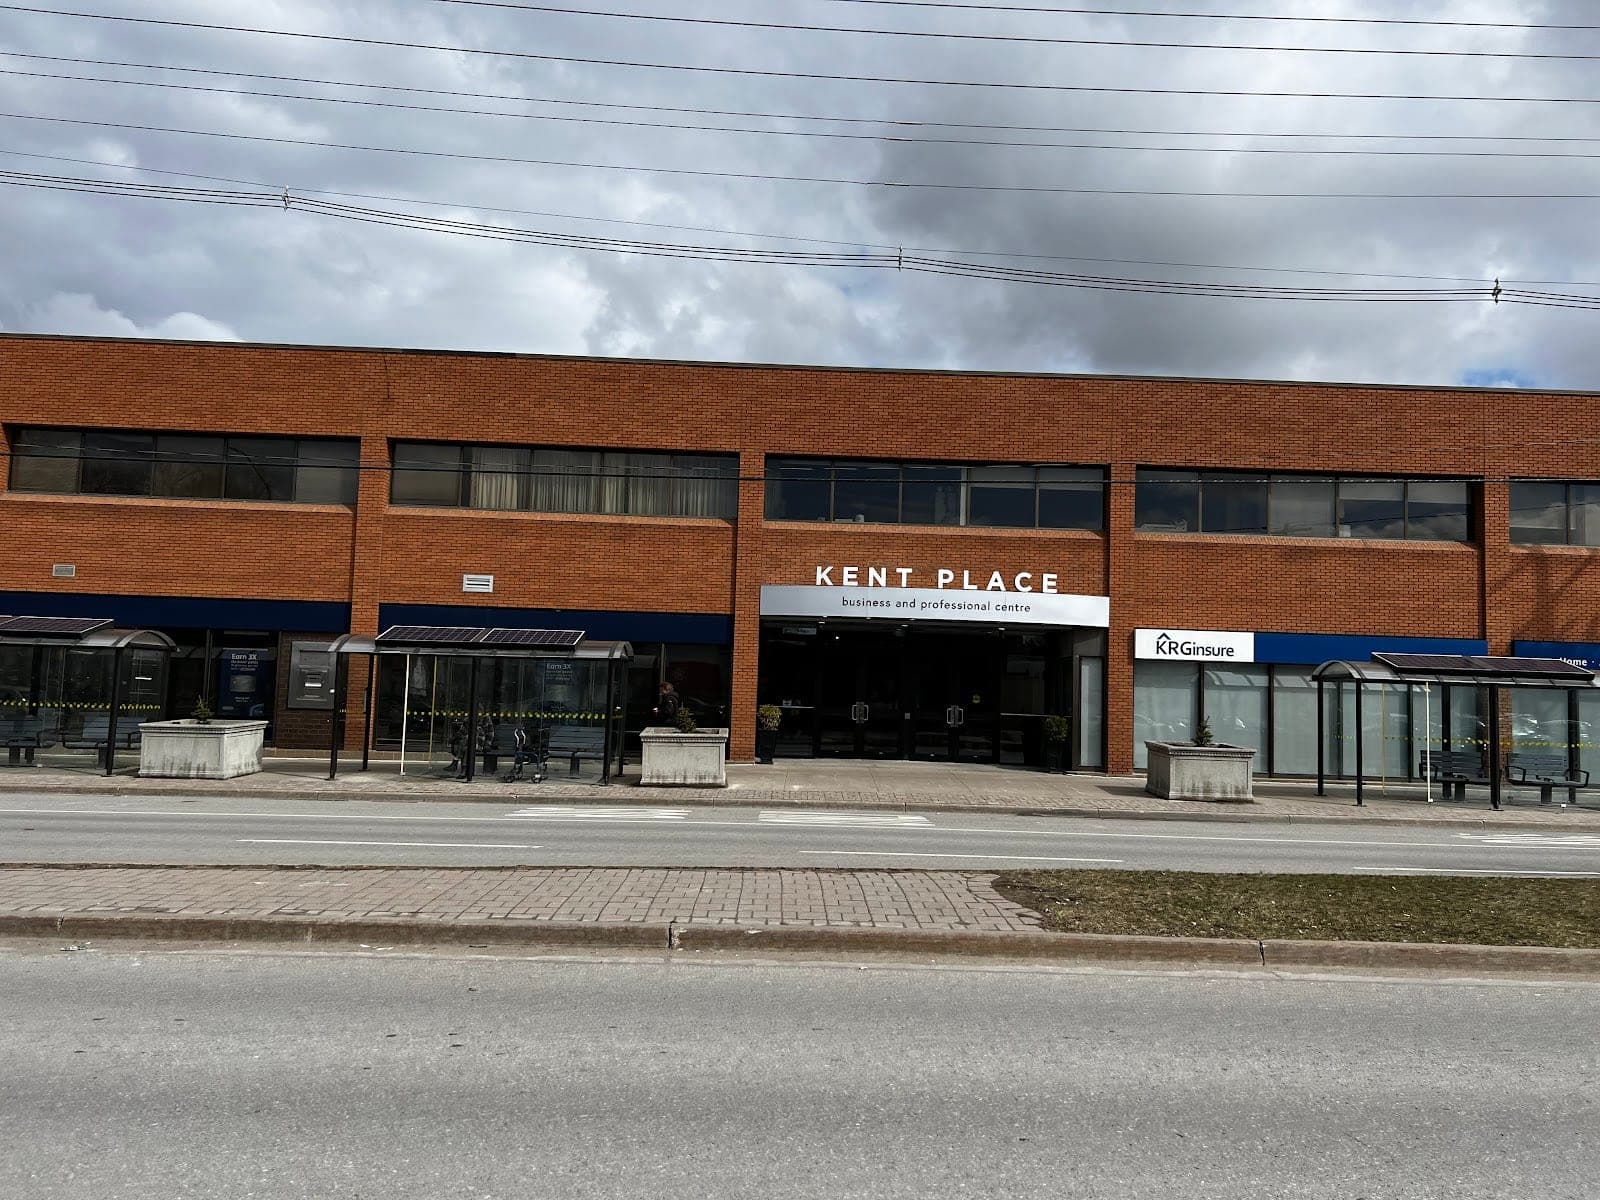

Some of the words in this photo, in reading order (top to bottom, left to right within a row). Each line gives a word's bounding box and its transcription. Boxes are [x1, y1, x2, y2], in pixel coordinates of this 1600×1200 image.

[815, 565, 913, 588] KENT
[937, 568, 1059, 594] PLACE
[842, 596, 891, 607] business
[895, 598, 916, 608] and
[920, 599, 991, 612] professional
[994, 602, 1031, 613] centre
[1155, 638, 1235, 657] KRGinsure
